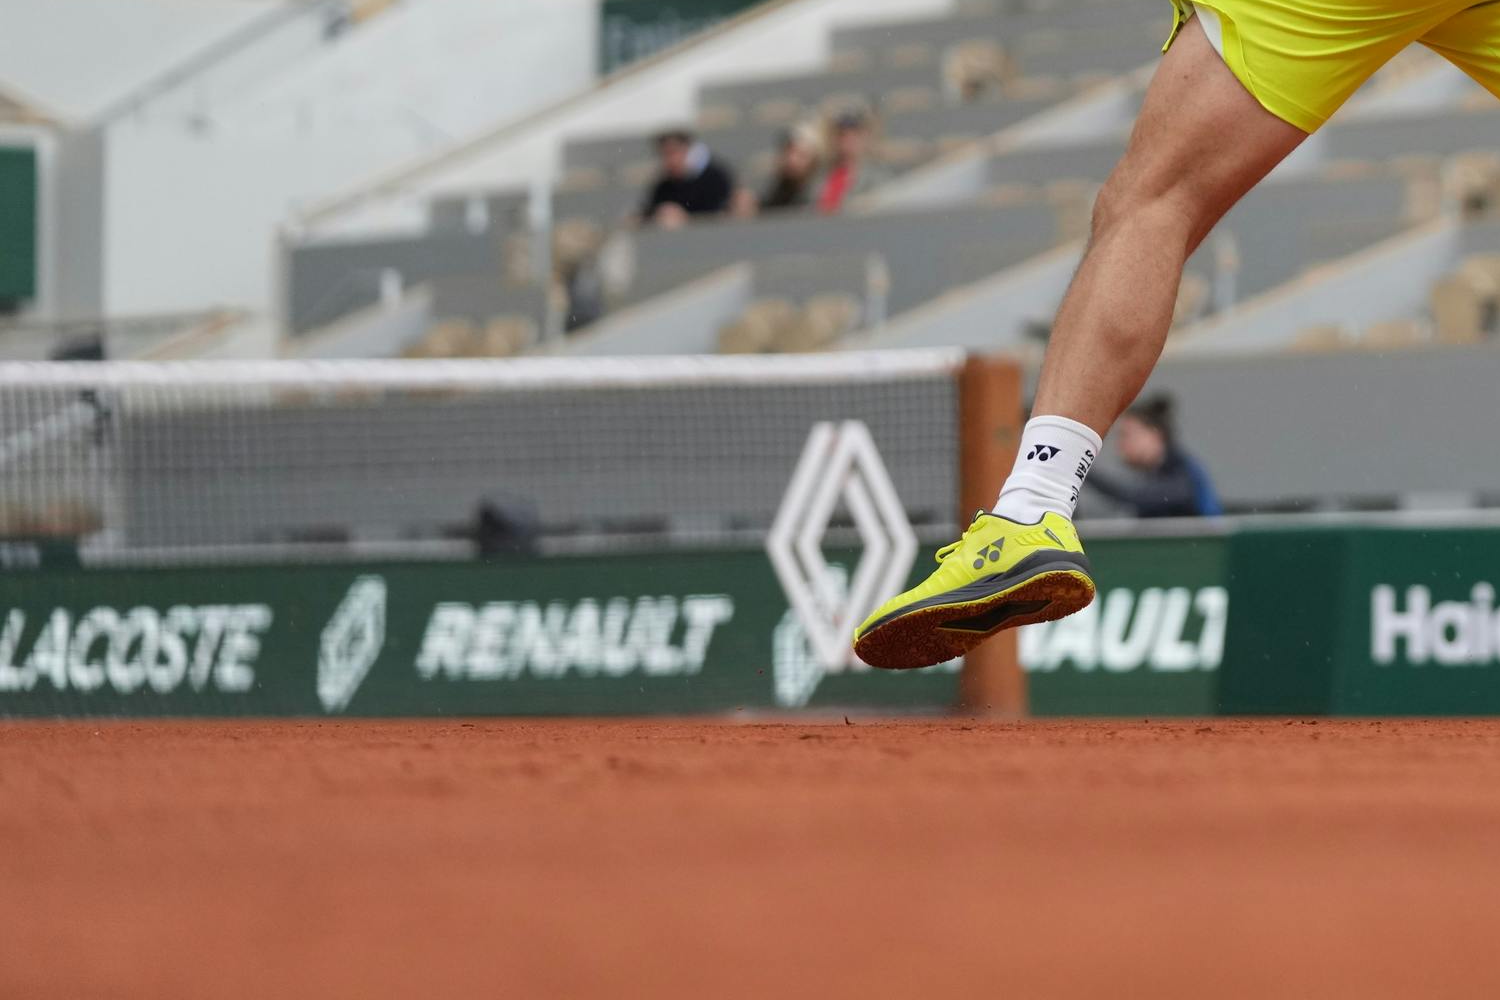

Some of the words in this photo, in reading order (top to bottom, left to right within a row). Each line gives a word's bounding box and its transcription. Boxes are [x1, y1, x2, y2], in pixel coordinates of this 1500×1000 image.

[1075, 449, 1095, 481] STAN
[0, 603, 273, 692] LACOSTE
[414, 594, 734, 680] RENAULT
